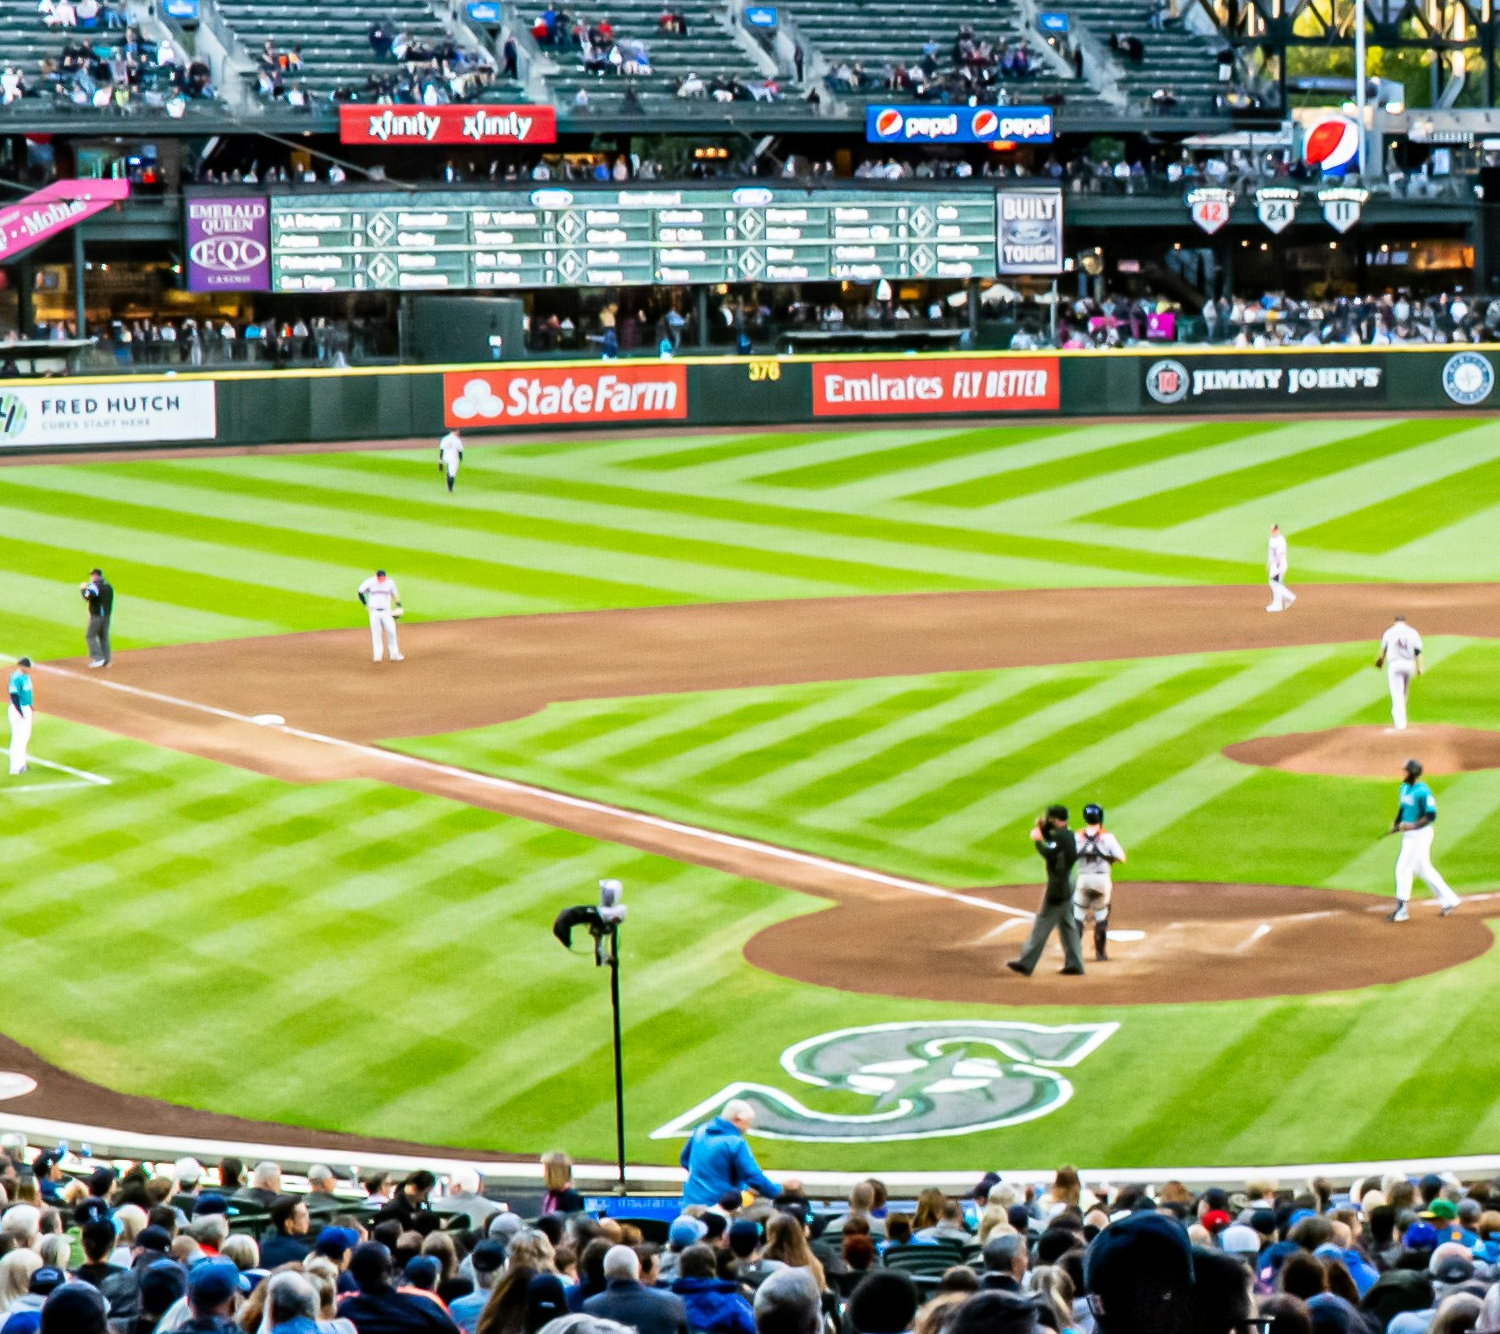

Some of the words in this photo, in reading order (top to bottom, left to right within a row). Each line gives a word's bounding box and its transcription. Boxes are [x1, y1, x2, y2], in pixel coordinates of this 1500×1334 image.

[369, 111, 441, 142] xfinity
[462, 111, 532, 142] xfinity
[905, 113, 958, 138] pepsi
[1000, 113, 1052, 138] pepsi
[1003, 198, 1056, 220] BUILT
[1200, 203, 1221, 221] 42
[1267, 203, 1286, 220] 24
[1336, 202, 1350, 220] 11
[202, 218, 254, 234] QUEEN
[824, 372, 944, 403] Emirates
[952, 372, 982, 399] FLY
[985, 370, 1048, 398] BETTER
[1193, 369, 1282, 396] JIMMY
[1288, 367, 1383, 394] JOHN'S
[40, 395, 98, 416] FRED
[106, 393, 181, 414] HUTCH
